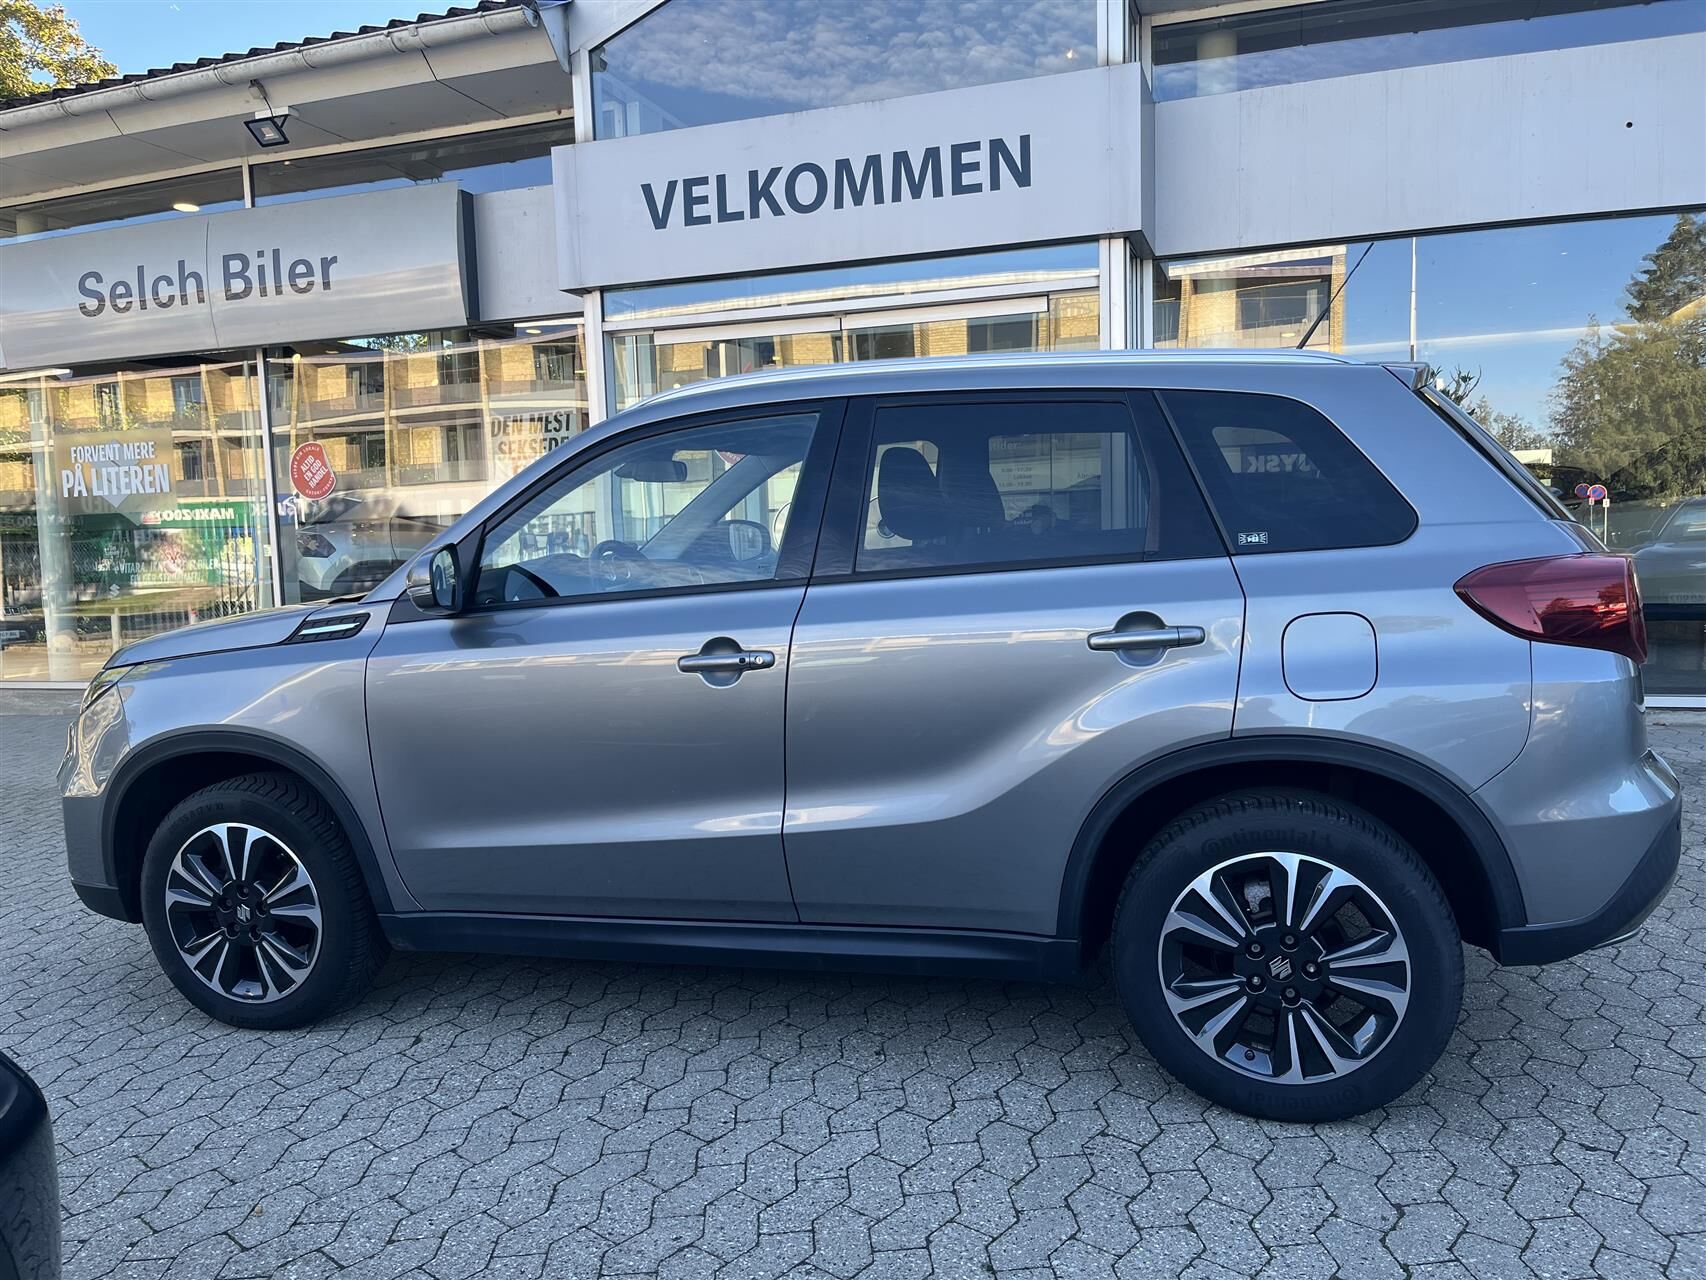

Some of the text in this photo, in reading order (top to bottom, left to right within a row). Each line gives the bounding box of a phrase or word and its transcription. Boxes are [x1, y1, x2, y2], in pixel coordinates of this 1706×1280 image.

[640, 134, 1032, 230] VELKOMMEN
[78, 248, 338, 317] Selch Biler
[491, 411, 573, 438] DEN MEST
[70, 441, 156, 463] FORVENT MERE
[300, 455, 315, 473] ALTID
[61, 463, 170, 498] PÅ LITEREN
[304, 459, 322, 482] EN GOD
[308, 466, 329, 489] HANDEL
